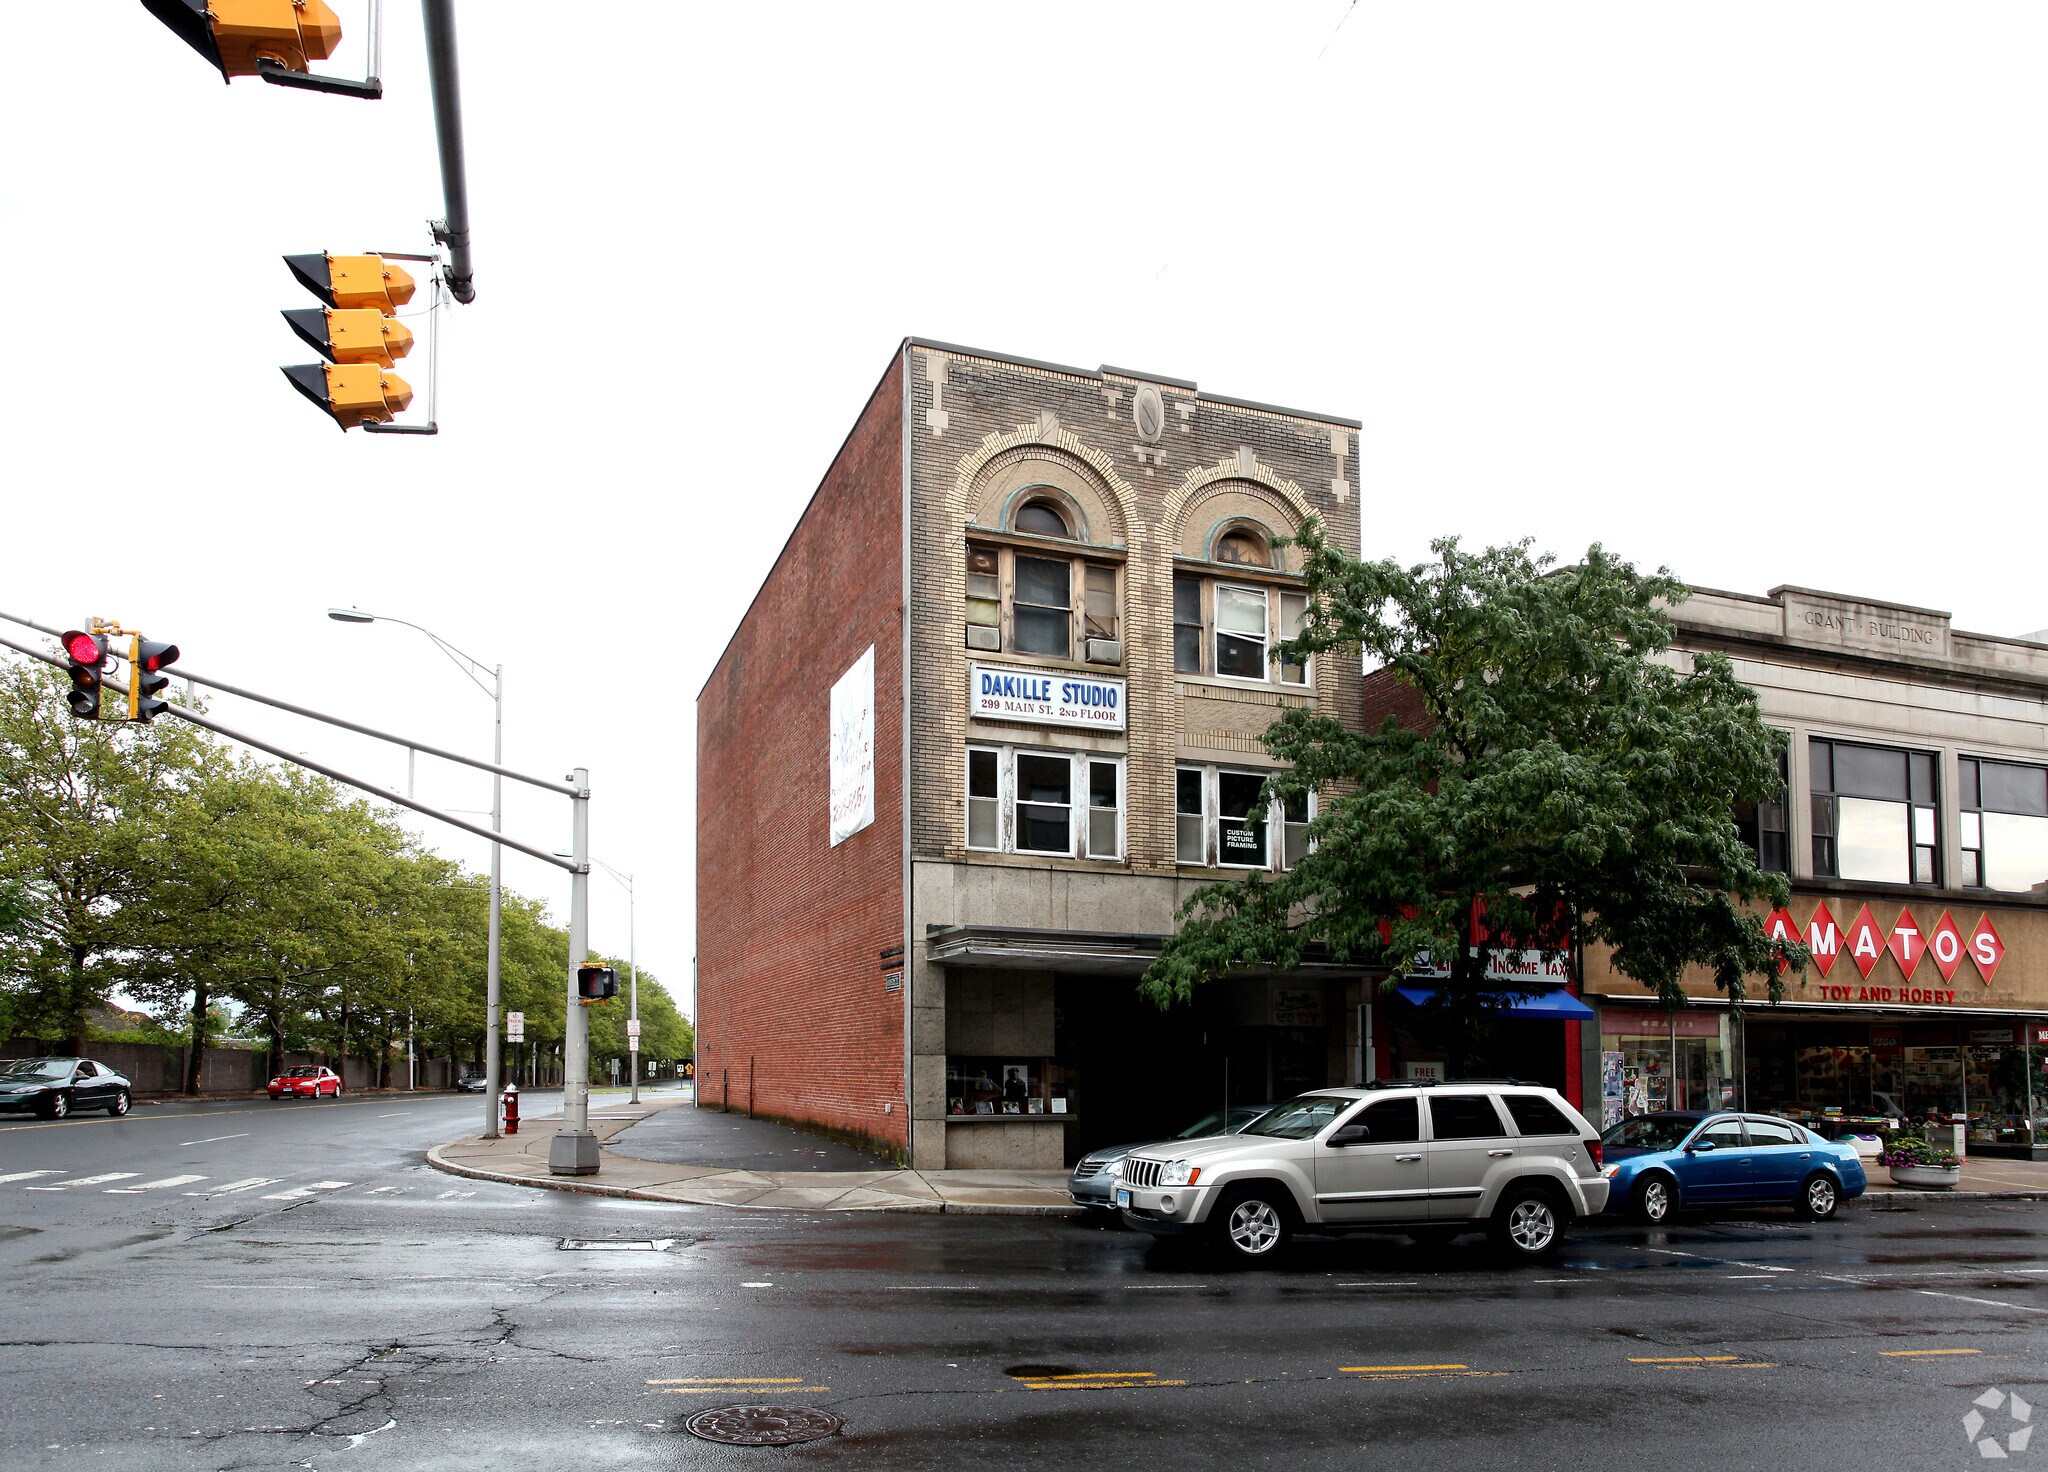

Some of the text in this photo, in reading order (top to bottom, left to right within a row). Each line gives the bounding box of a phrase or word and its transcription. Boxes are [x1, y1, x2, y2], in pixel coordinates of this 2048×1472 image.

[1804, 611, 1933, 645] GRANT BUILDING
[981, 673, 1118, 708] DAKILLE STUDIO
[981, 698, 1117, 722] 299 MAIN ST. 2ND FLOOR
[1226, 829, 1254, 837] CUSTOM
[1226, 835, 1254, 843] PICTURE
[1226, 841, 1258, 850] FRAMING
[1819, 985, 1853, 1001] TOY
[1859, 986, 1893, 1003] AND
[1899, 987, 1956, 1005] HOBBY
[1872, 1037, 1897, 1047] LEGO
[1414, 1067, 1436, 1078] FREE
